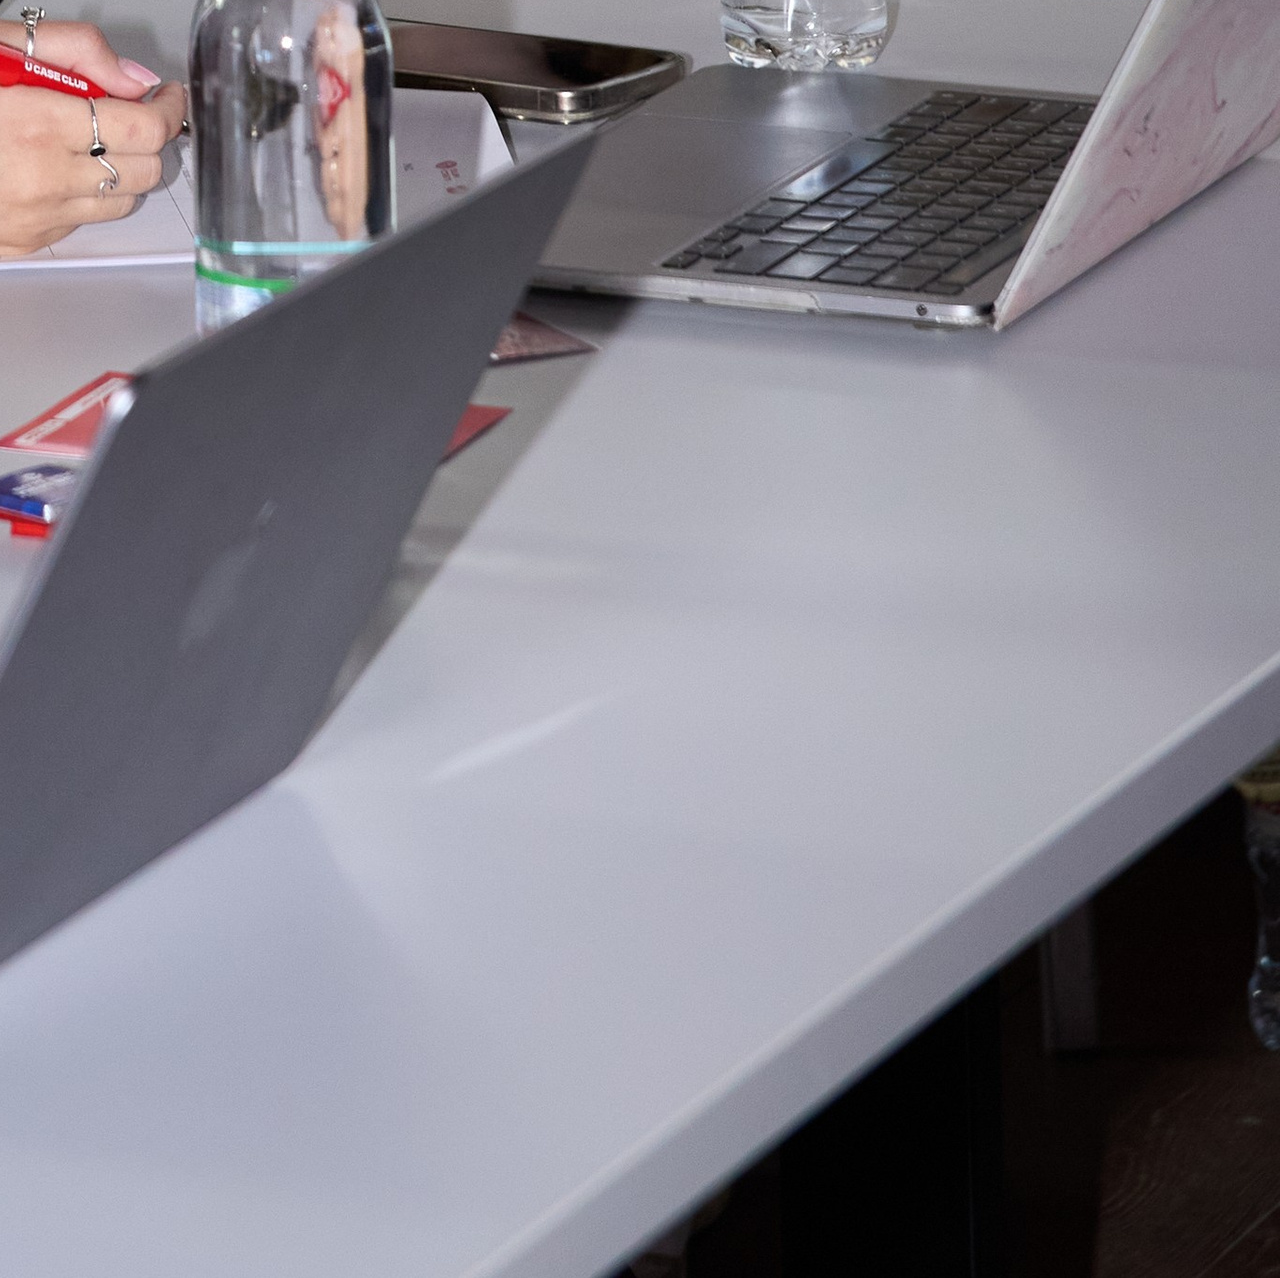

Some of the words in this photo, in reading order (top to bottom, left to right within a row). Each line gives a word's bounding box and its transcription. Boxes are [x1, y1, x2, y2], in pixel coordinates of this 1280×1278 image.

[24, 60, 33, 71] U
[33, 64, 61, 82] CASE
[61, 74, 89, 91] CLUB
